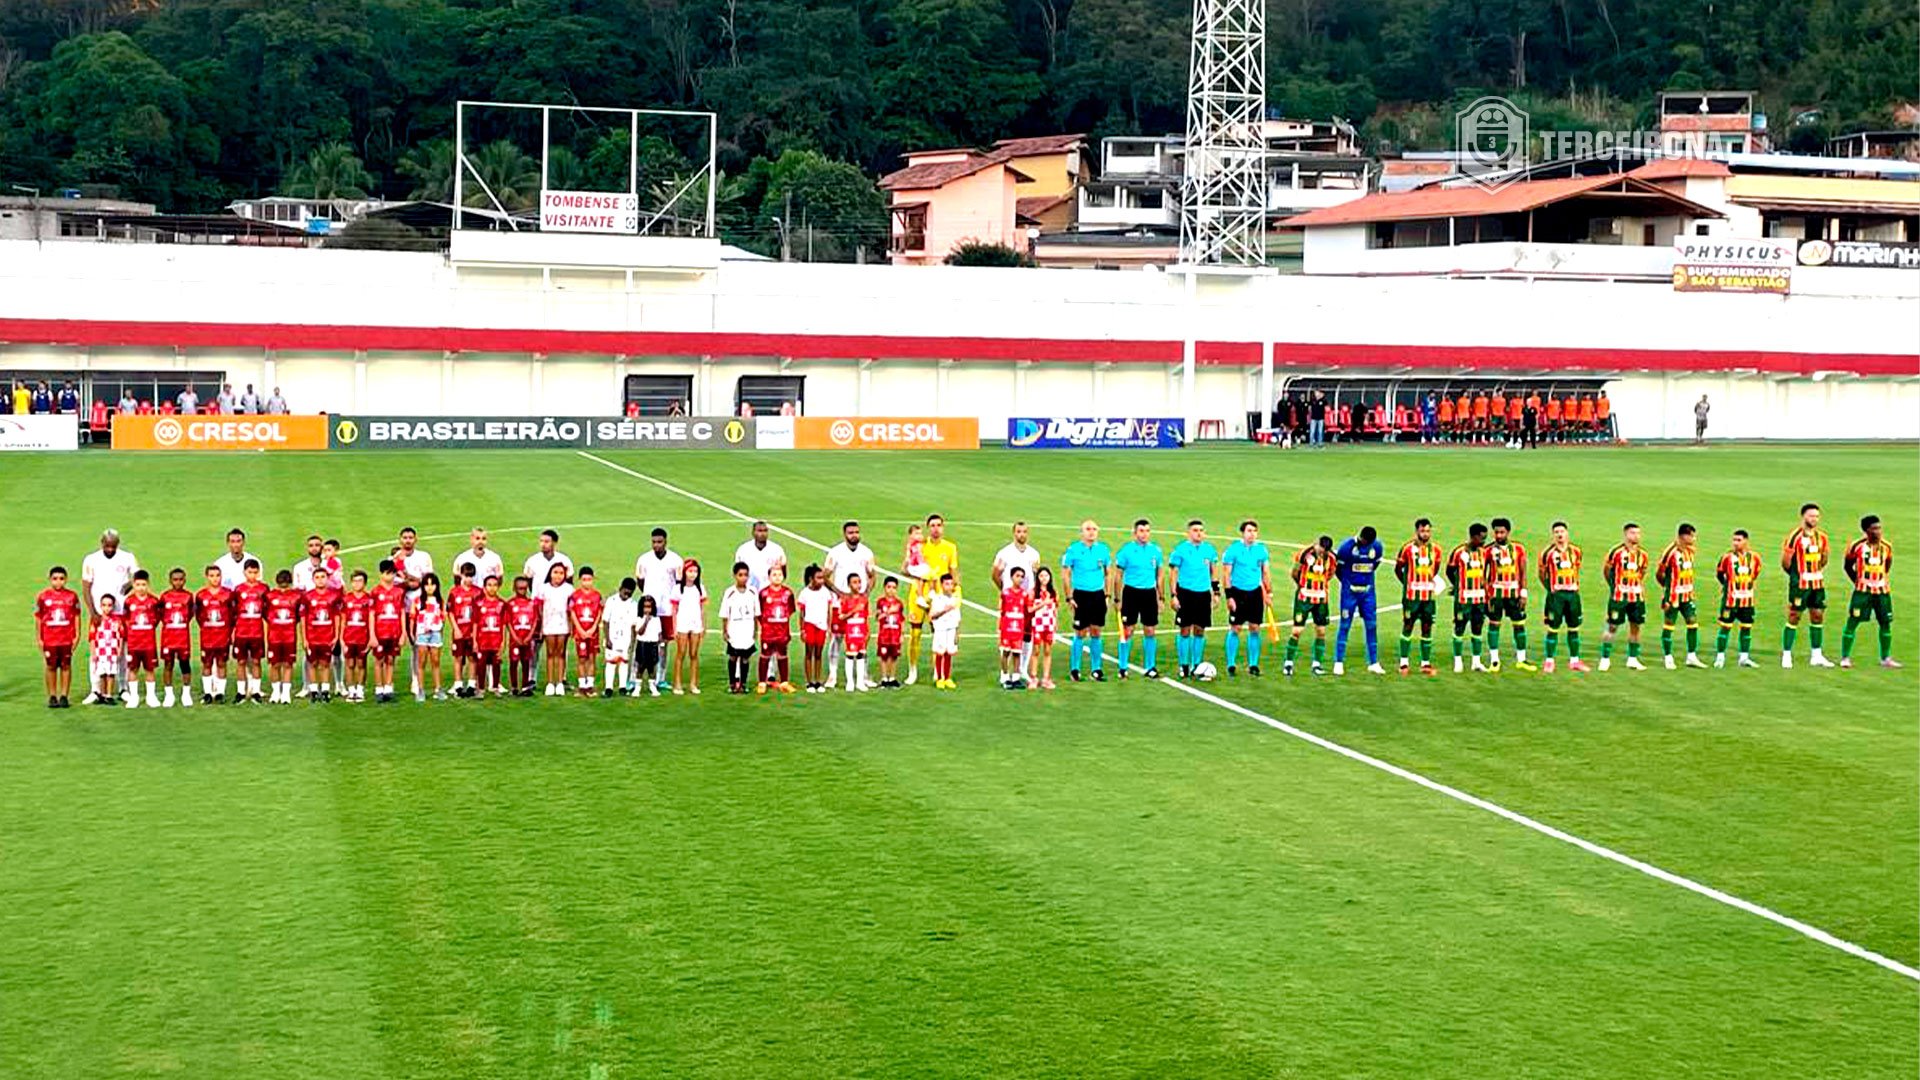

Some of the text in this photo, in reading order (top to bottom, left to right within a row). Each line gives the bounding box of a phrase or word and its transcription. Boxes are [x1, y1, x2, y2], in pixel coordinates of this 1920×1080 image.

[545, 195, 620, 209] TOMBENSE
[545, 214, 615, 228] VISITANTE
[1684, 245, 1783, 260] PHYSICUS
[1833, 246, 1920, 265] MARINH
[1687, 266, 1791, 278] SUPERMERCADO
[1690, 275, 1787, 288] SÃO SEBASTIÃO
[188, 421, 287, 441] CRESOL
[369, 417, 713, 441] BRASILEIRÃO SÉRIE C
[859, 422, 944, 442] CRESOL
